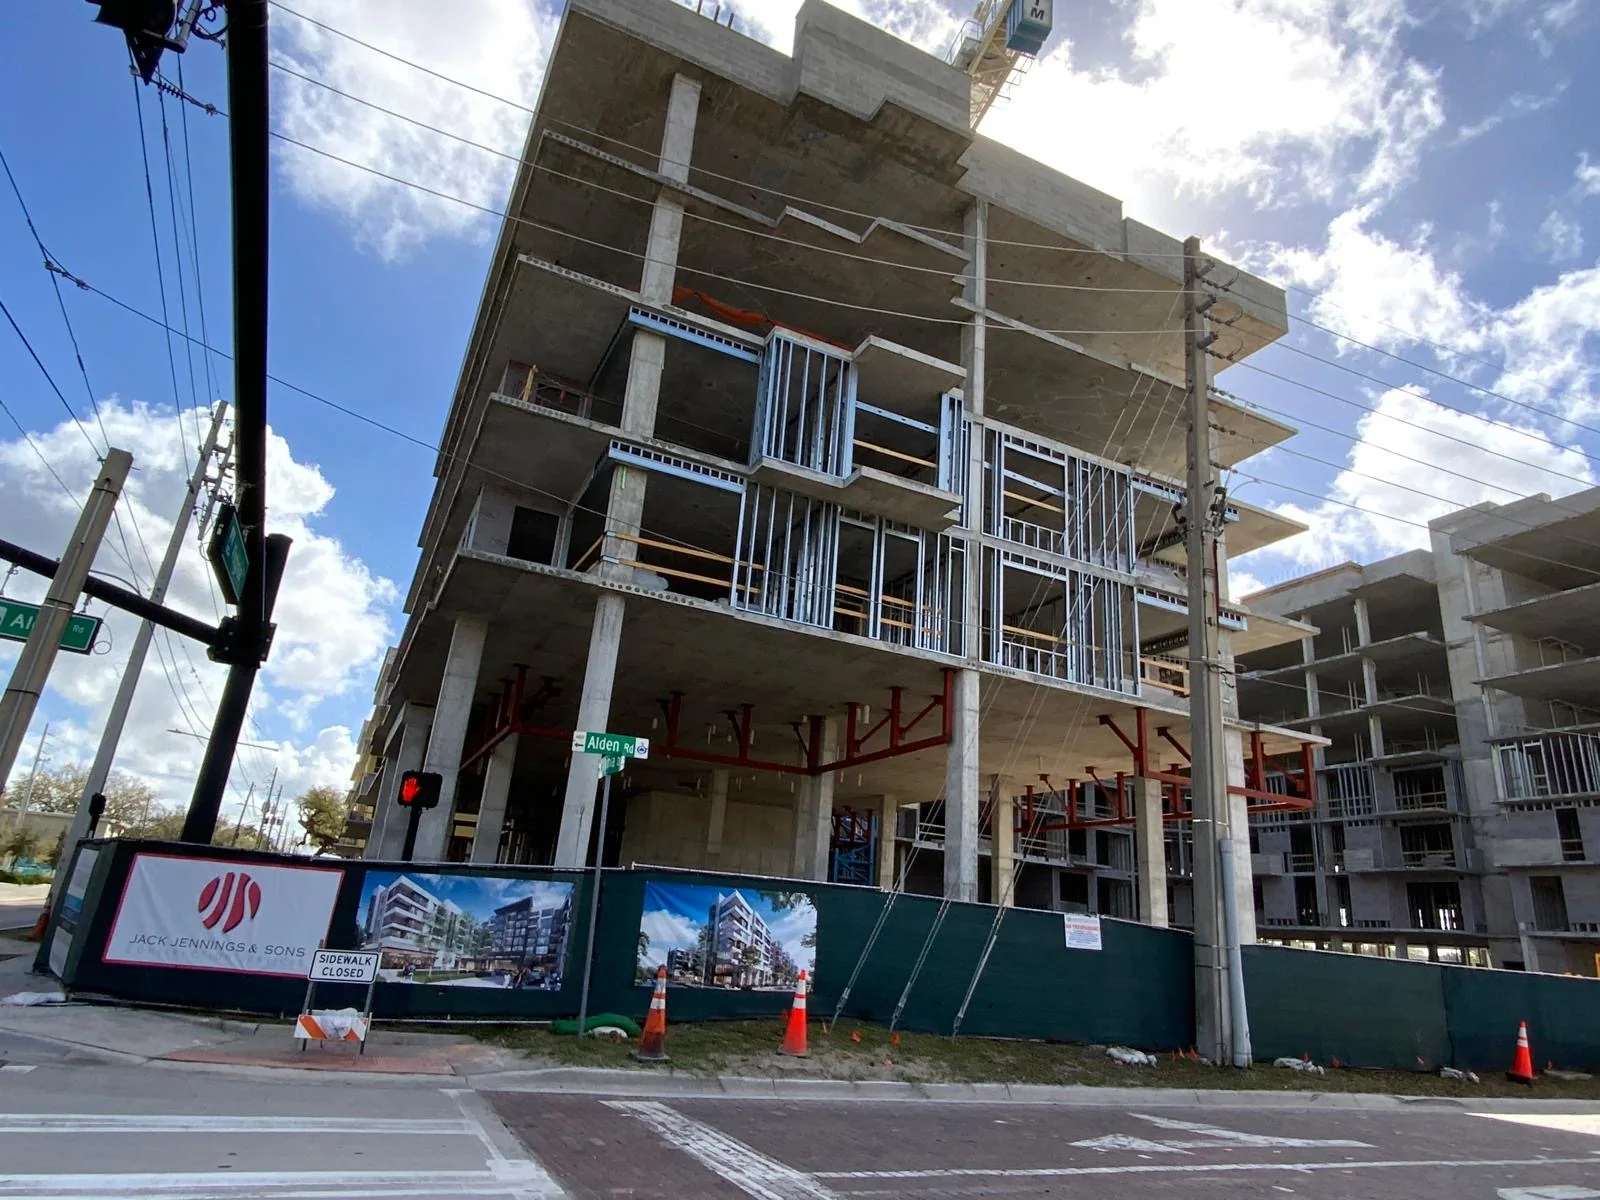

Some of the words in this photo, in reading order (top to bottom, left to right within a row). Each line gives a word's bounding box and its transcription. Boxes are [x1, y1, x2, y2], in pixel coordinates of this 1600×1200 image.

[587, 735, 620, 752] Alden
[623, 742, 634, 754] Rd
[129, 933, 168, 947] JACK
[170, 936, 246, 953] JENNINGS
[247, 943, 258, 954] &
[264, 944, 306, 958] SONS
[319, 953, 372, 966] SIDEWALK
[322, 966, 364, 978] CLOSED
